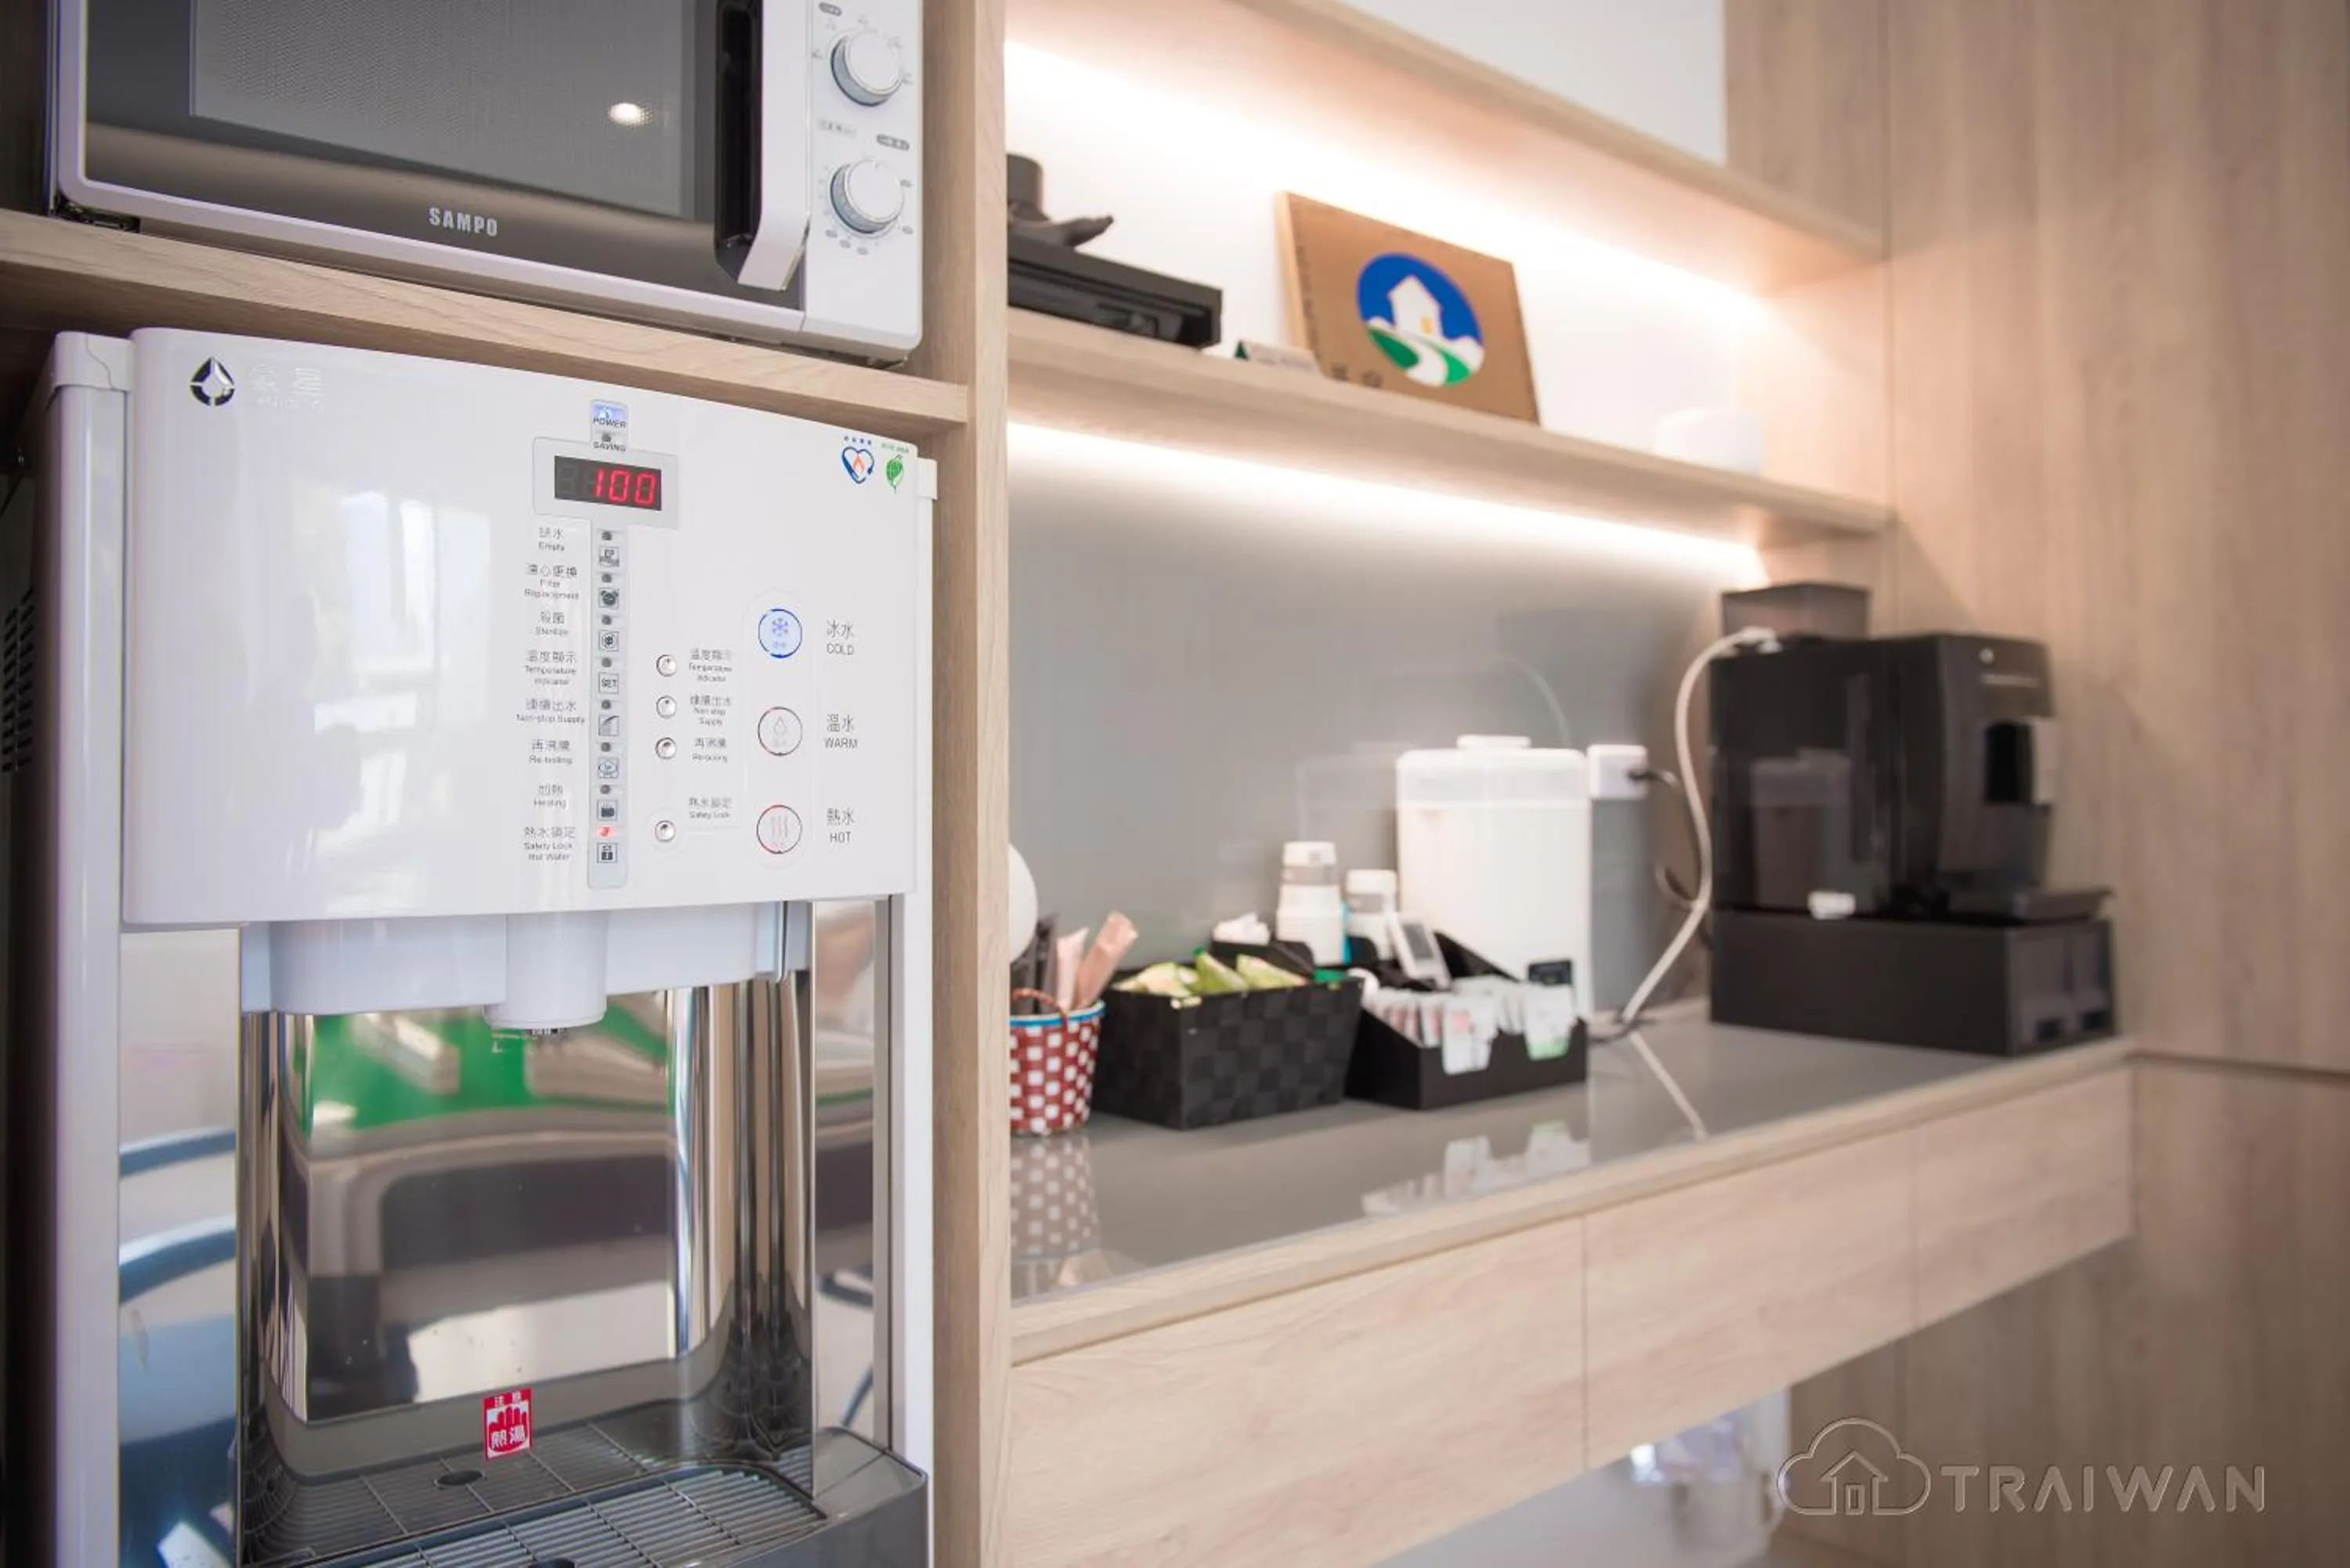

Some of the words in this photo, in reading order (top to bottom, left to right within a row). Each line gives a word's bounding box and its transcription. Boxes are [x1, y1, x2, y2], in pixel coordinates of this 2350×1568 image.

[428, 207, 497, 237] SAMPO
[593, 417, 626, 428] POWER
[593, 441, 627, 452] SAVING
[593, 468, 656, 505] 100
[826, 620, 855, 638] 冰水
[826, 643, 855, 656] COLD
[826, 714, 855, 733] 溫水
[824, 738, 859, 750] WARM
[826, 807, 855, 826] 熱水
[830, 832, 851, 844] HOT
